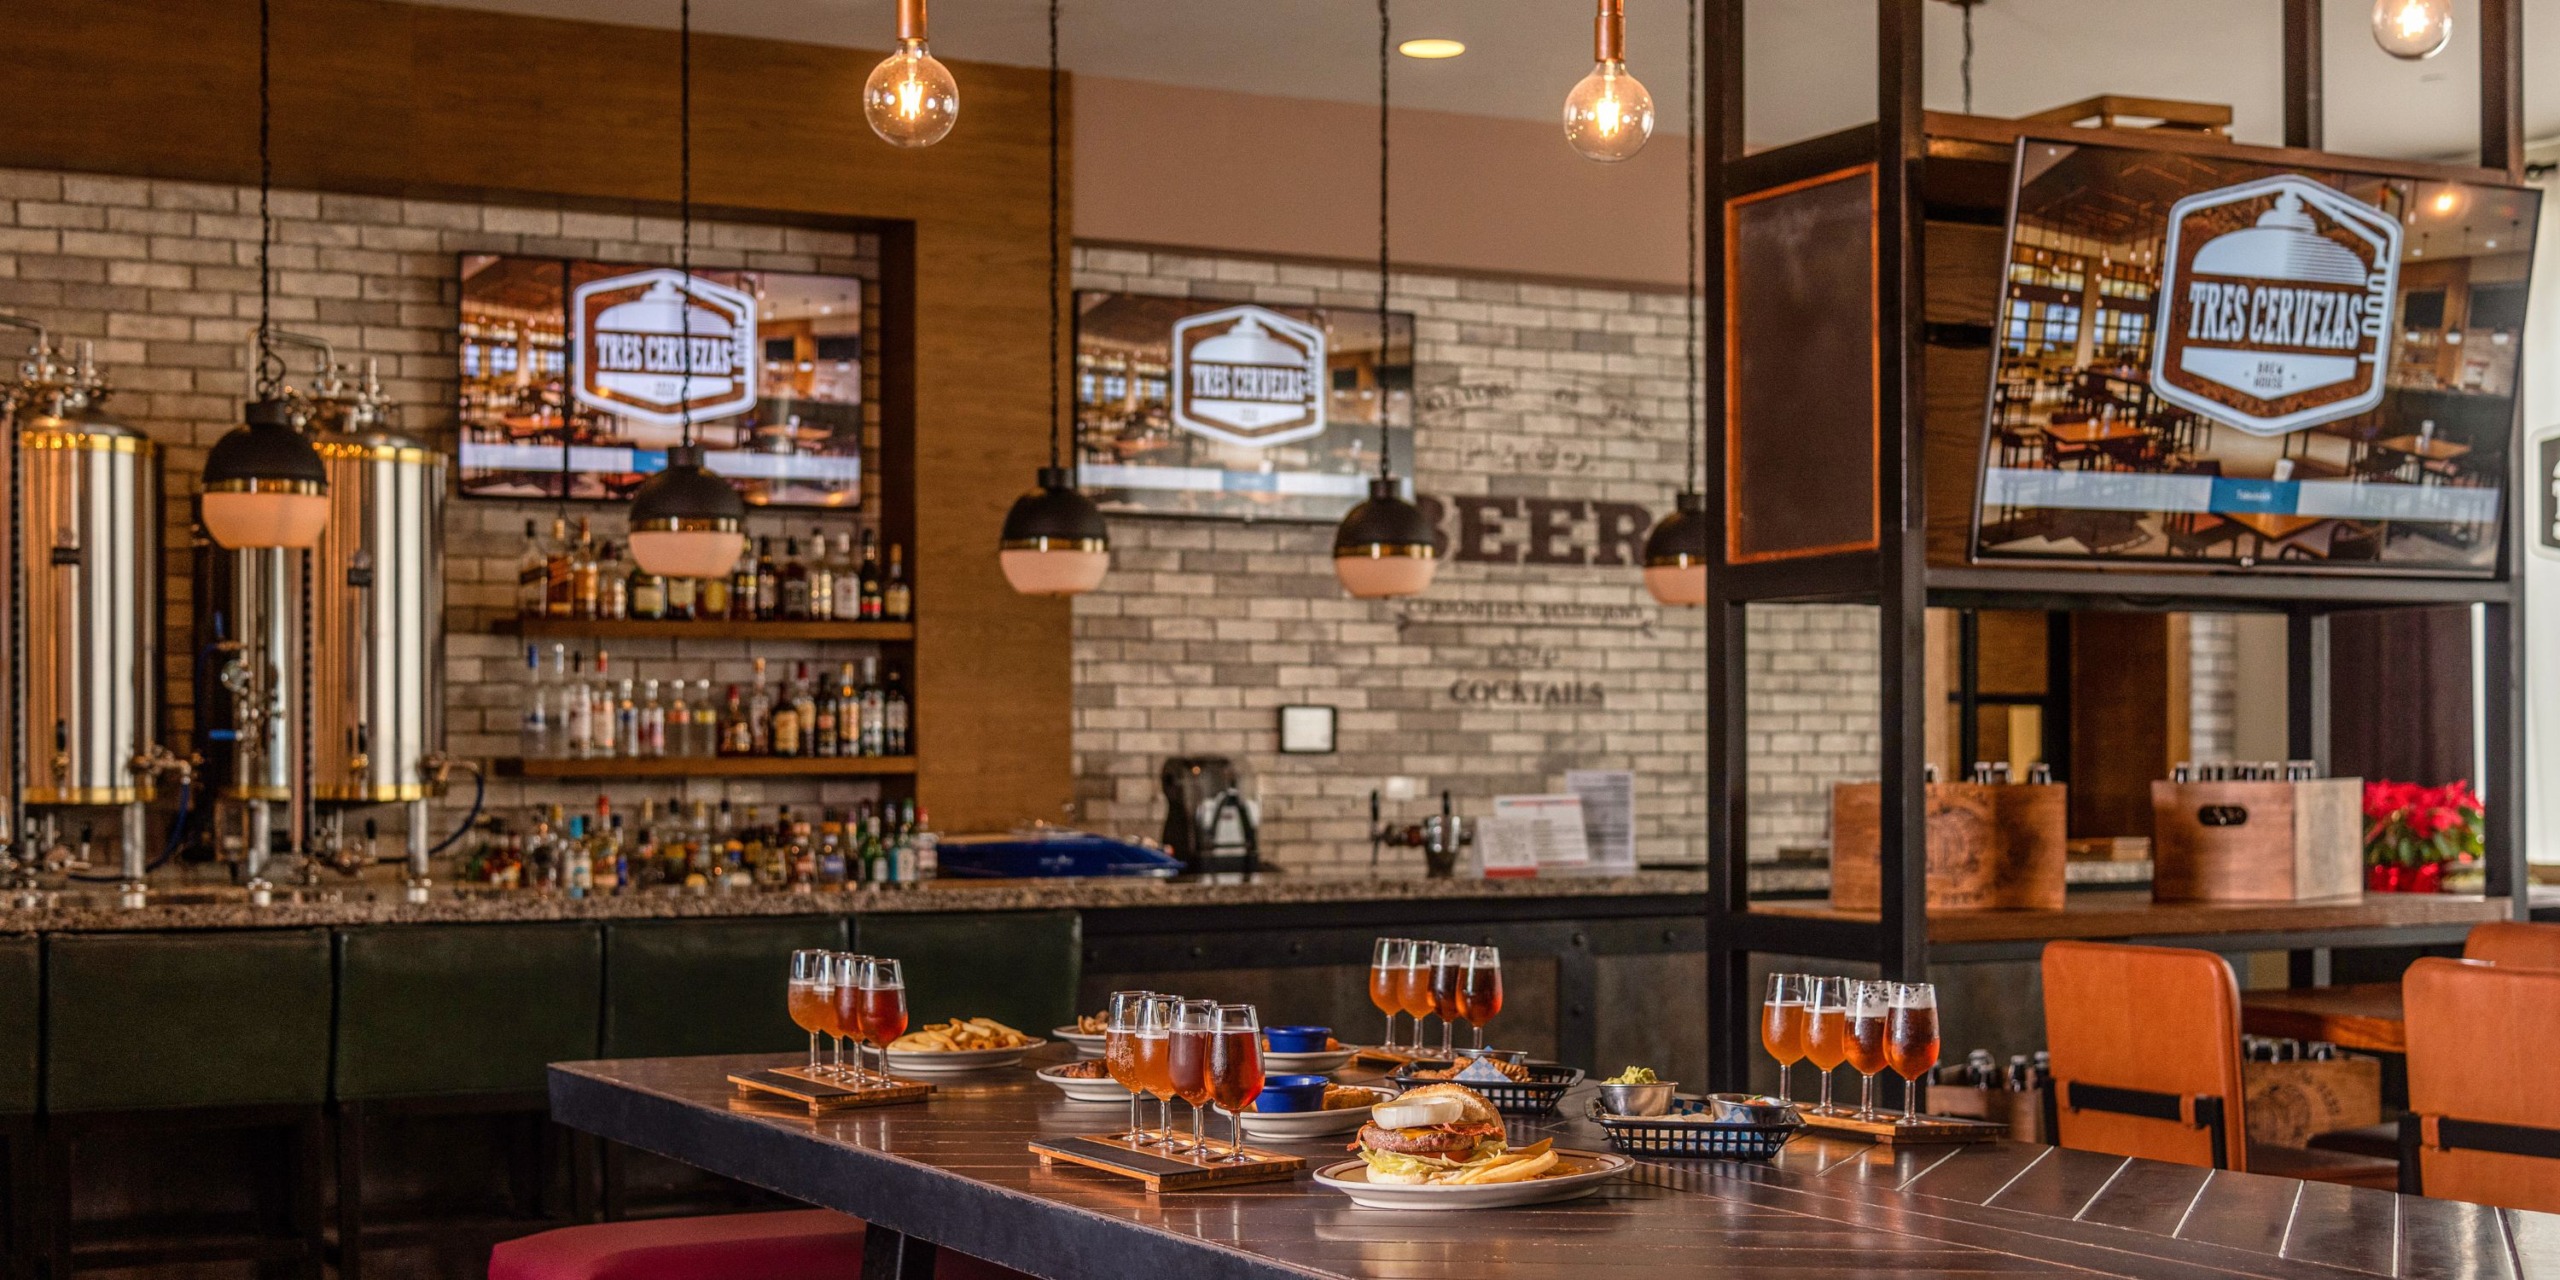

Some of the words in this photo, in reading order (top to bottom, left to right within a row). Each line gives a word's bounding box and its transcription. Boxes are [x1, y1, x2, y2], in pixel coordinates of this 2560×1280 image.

[2188, 281, 2249, 342] TRES
[2249, 286, 2363, 349] CERVEZAS
[595, 334, 643, 370] TRES
[1449, 679, 1604, 704] COCKTAILS
